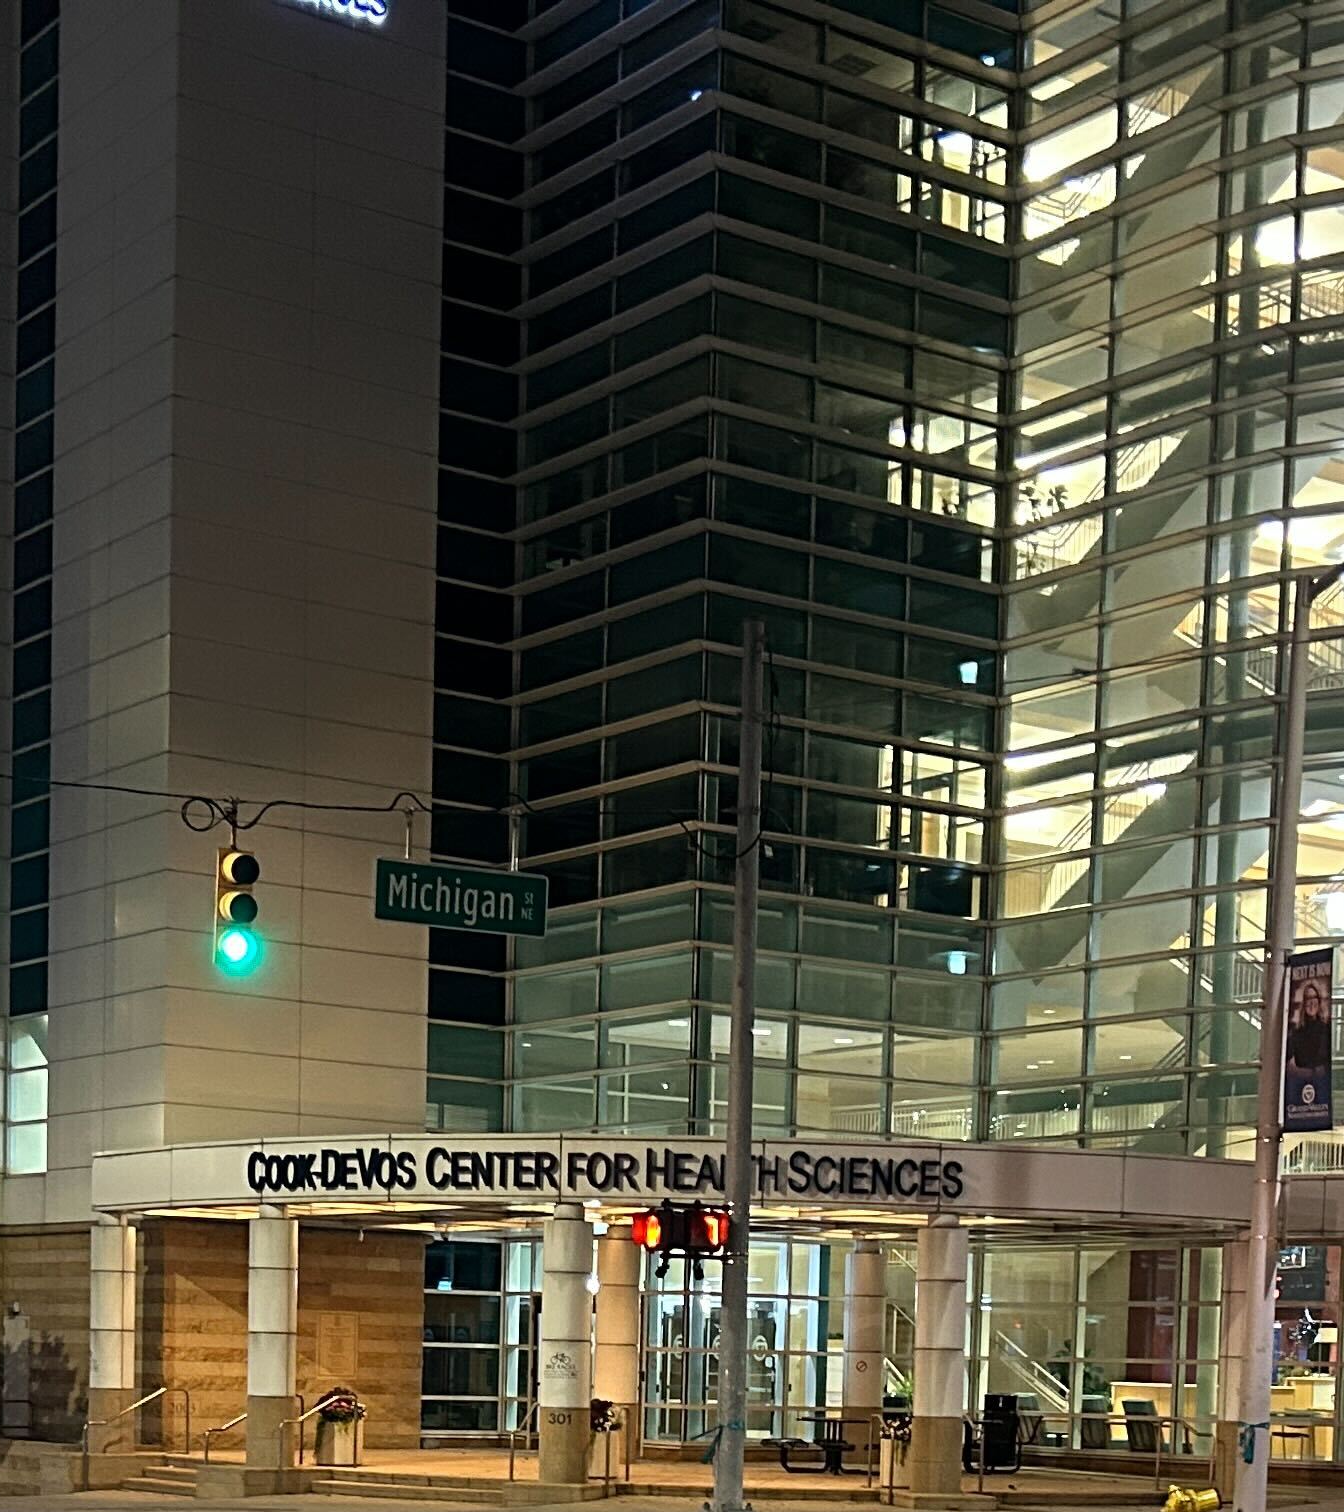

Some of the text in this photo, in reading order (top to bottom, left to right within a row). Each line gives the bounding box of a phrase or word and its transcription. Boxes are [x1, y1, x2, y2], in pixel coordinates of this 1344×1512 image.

[388, 872, 514, 926] Michigan
[521, 907, 534, 921] NE
[425, 1147, 561, 1190] CENTER
[567, 1151, 641, 1191] FOR
[787, 1150, 964, 1198] SCIENCES
[548, 1412, 572, 1425] 301
